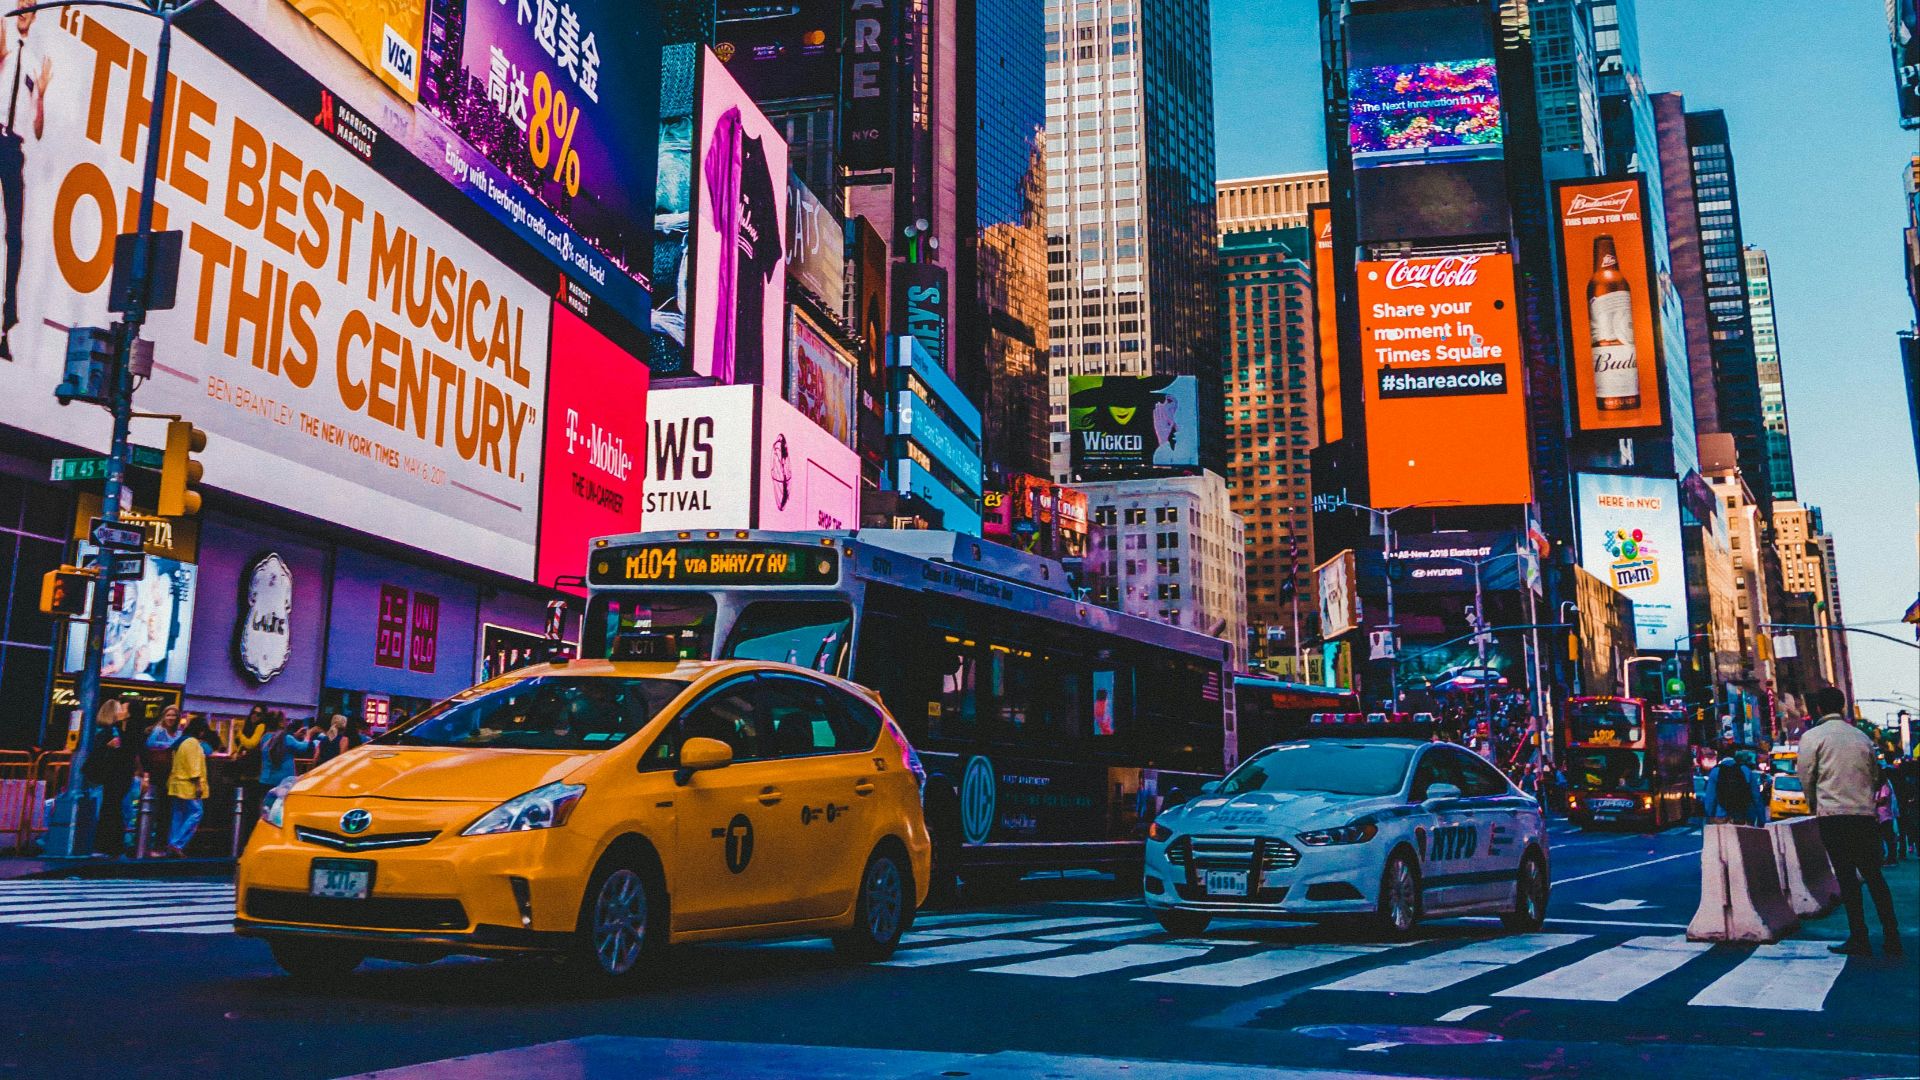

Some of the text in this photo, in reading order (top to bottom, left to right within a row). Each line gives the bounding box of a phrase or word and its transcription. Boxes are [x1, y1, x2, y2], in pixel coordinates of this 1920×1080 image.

[386, 34, 413, 81] VISA
[1362, 103, 1380, 112] The
[1382, 101, 1406, 111] Next
[1407, 96, 1459, 109] Innovation
[1472, 94, 1485, 104] TV
[338, 105, 378, 143] MARRIOTT
[337, 123, 372, 158] MARQUIS
[445, 143, 469, 182] Enjoy
[469, 167, 487, 193] with
[488, 177, 526, 224] Everbright
[526, 212, 547, 240] credit
[575, 252, 589, 273] cash
[1564, 218, 1581, 226] THIS
[1605, 214, 1621, 223] FOR
[224, 115, 364, 286] BEST
[367, 210, 532, 390] MUSICAL
[1385, 256, 1481, 290] Coca-Cola
[189, 221, 322, 389] THIS
[1373, 301, 1472, 318] Share your
[1374, 321, 1474, 341] moment in
[1375, 344, 1502, 363] Times Square
[1382, 370, 1503, 391] #shareacoke
[207, 375, 232, 404] BEN
[235, 386, 295, 426] BRANTLEY
[300, 412, 318, 437] THE
[321, 421, 345, 448] NEW
[348, 431, 372, 457] YORK
[375, 443, 400, 469] TIMES
[403, 455, 422, 474] MAY
[80, 461, 94, 477] 45
[1598, 495, 1661, 510] HERE in NYC!
[625, 548, 677, 579] M104
[685, 558, 708, 573] VIA
[767, 553, 787, 573] AV
[1426, 568, 1463, 577] HYUNDAI
[415, 602, 435, 632] UNI
[412, 635, 434, 667] QLO
[1430, 825, 1478, 861] NYPD
